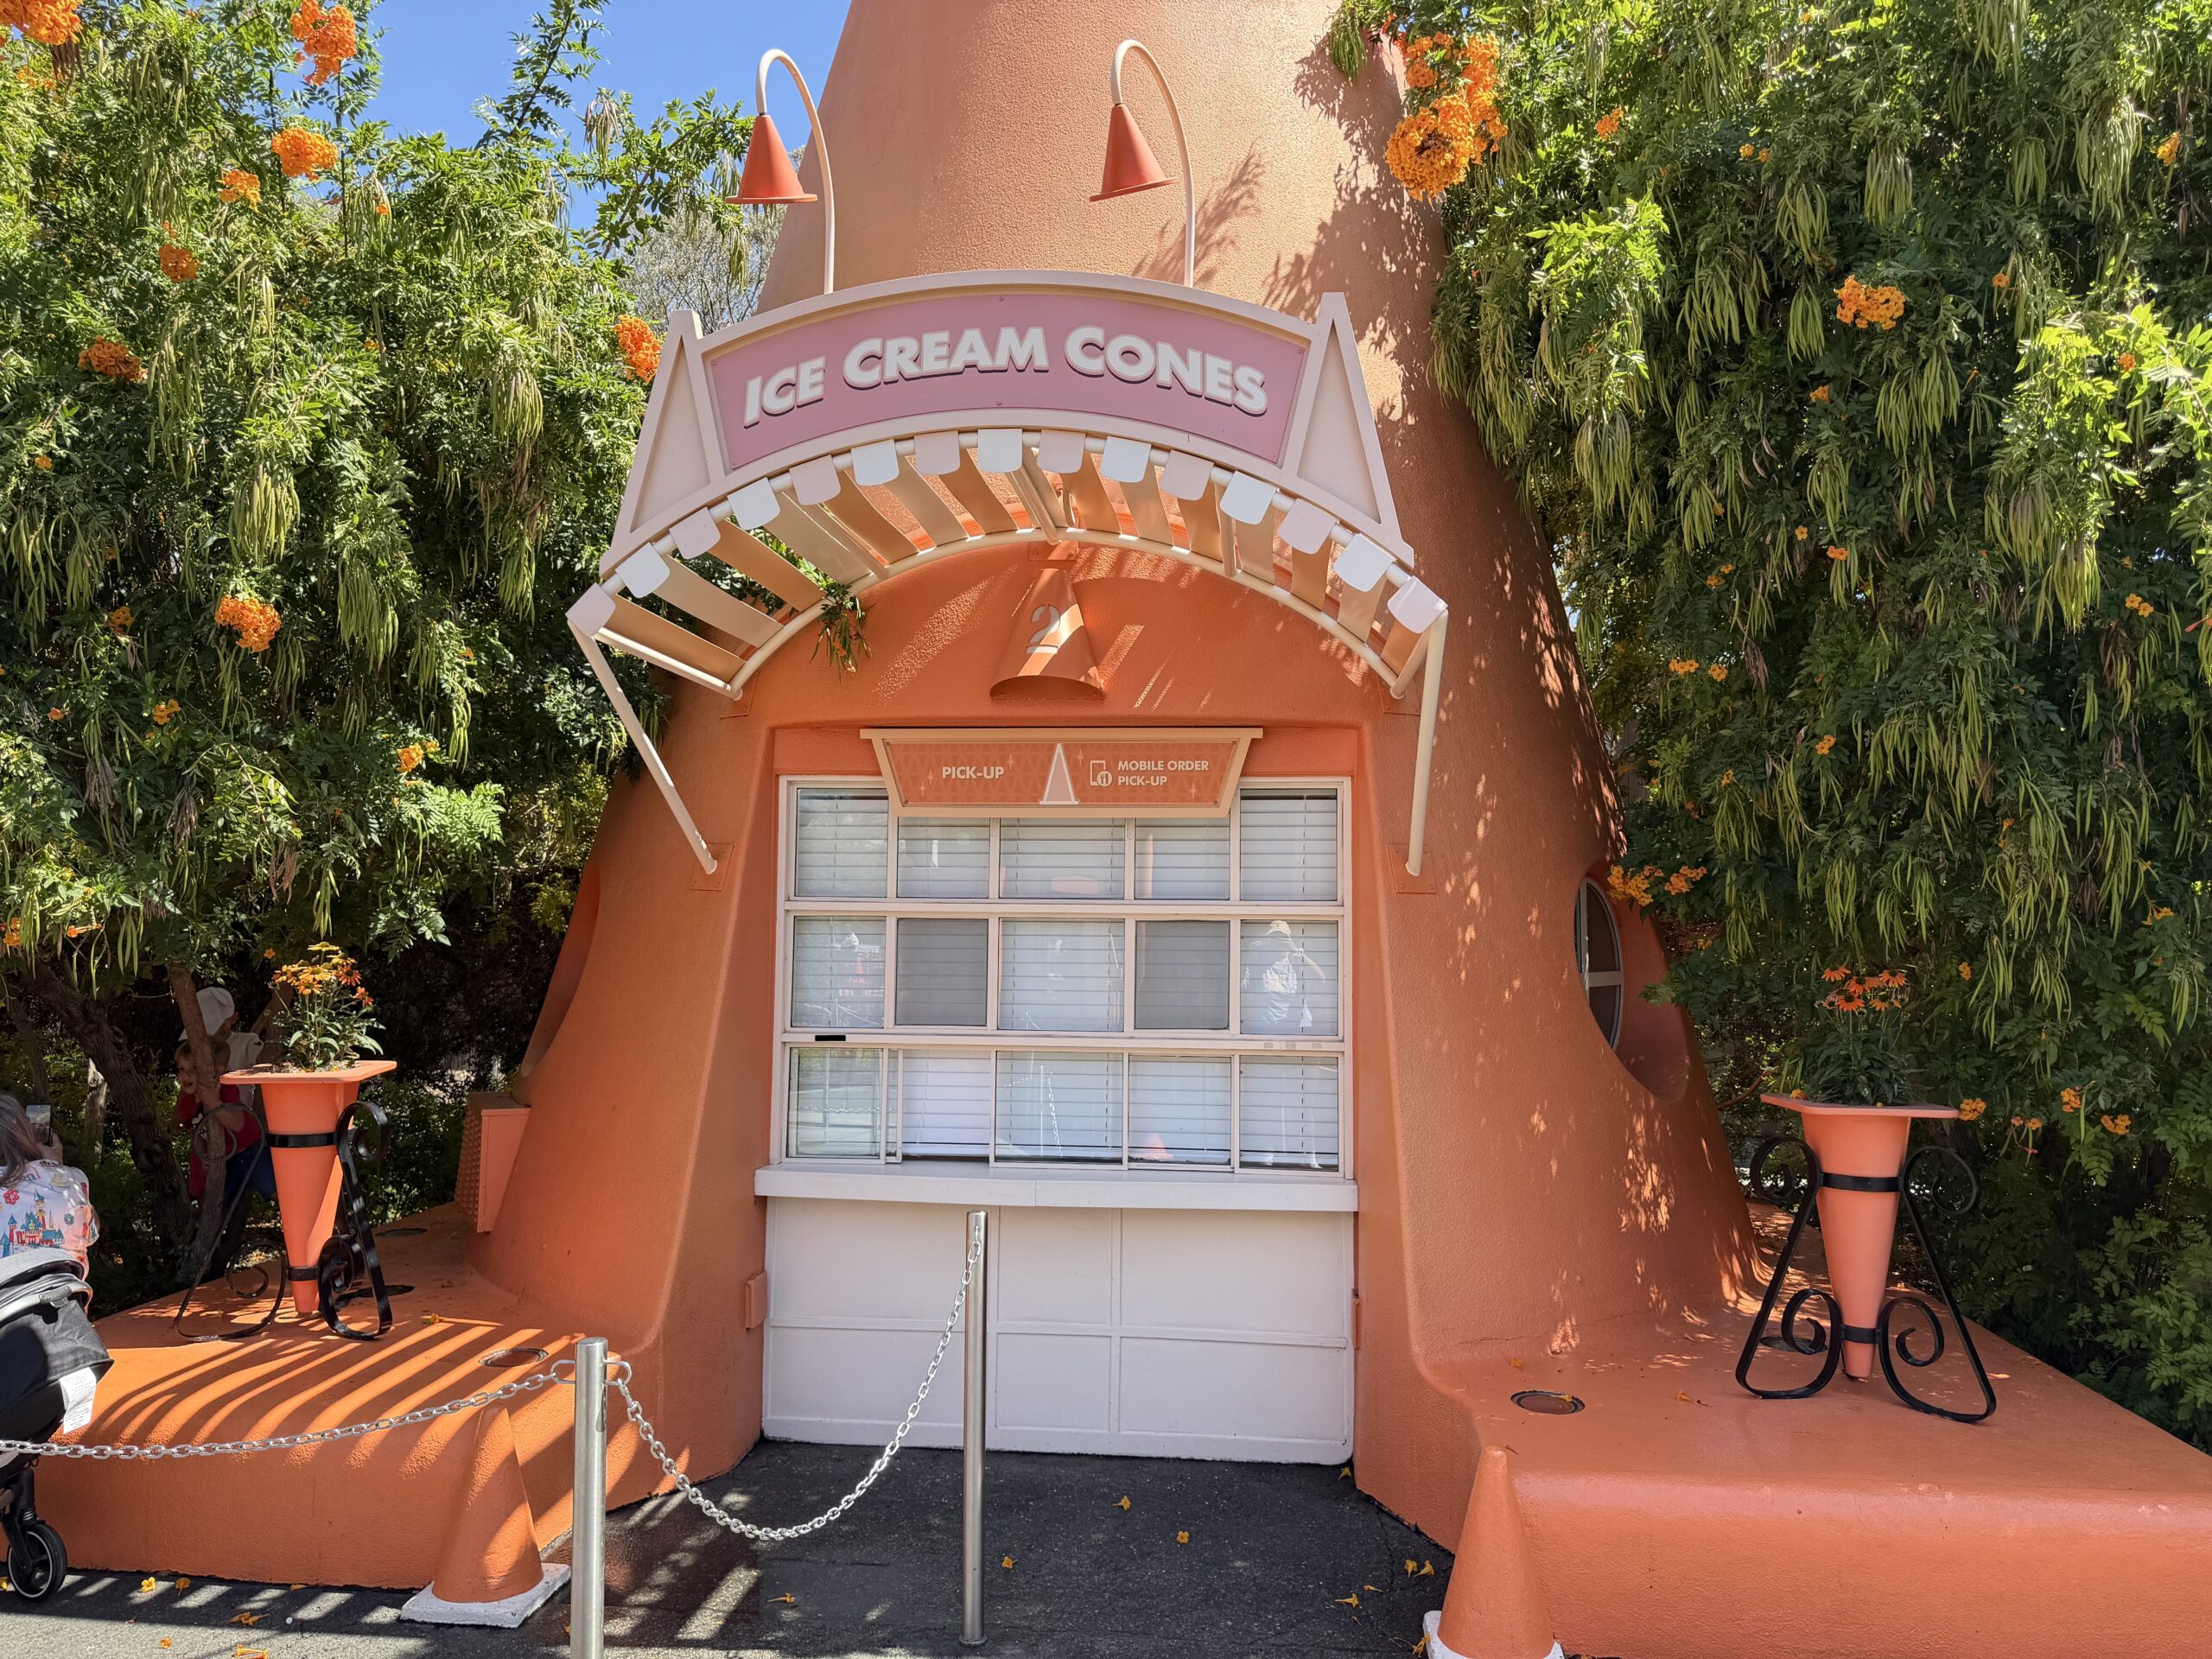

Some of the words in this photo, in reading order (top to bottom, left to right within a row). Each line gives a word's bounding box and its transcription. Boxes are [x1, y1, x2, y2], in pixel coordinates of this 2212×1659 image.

[743, 354, 826, 427] ICE
[842, 326, 1050, 389] CREAM
[1065, 325, 1268, 416] CONES
[1025, 604, 1061, 654] 2
[1117, 760, 1165, 771] MOBILE
[1166, 760, 1210, 771] ORDER
[942, 766, 1005, 779] PICK-UP
[1117, 775, 1168, 786] PICK-UP
